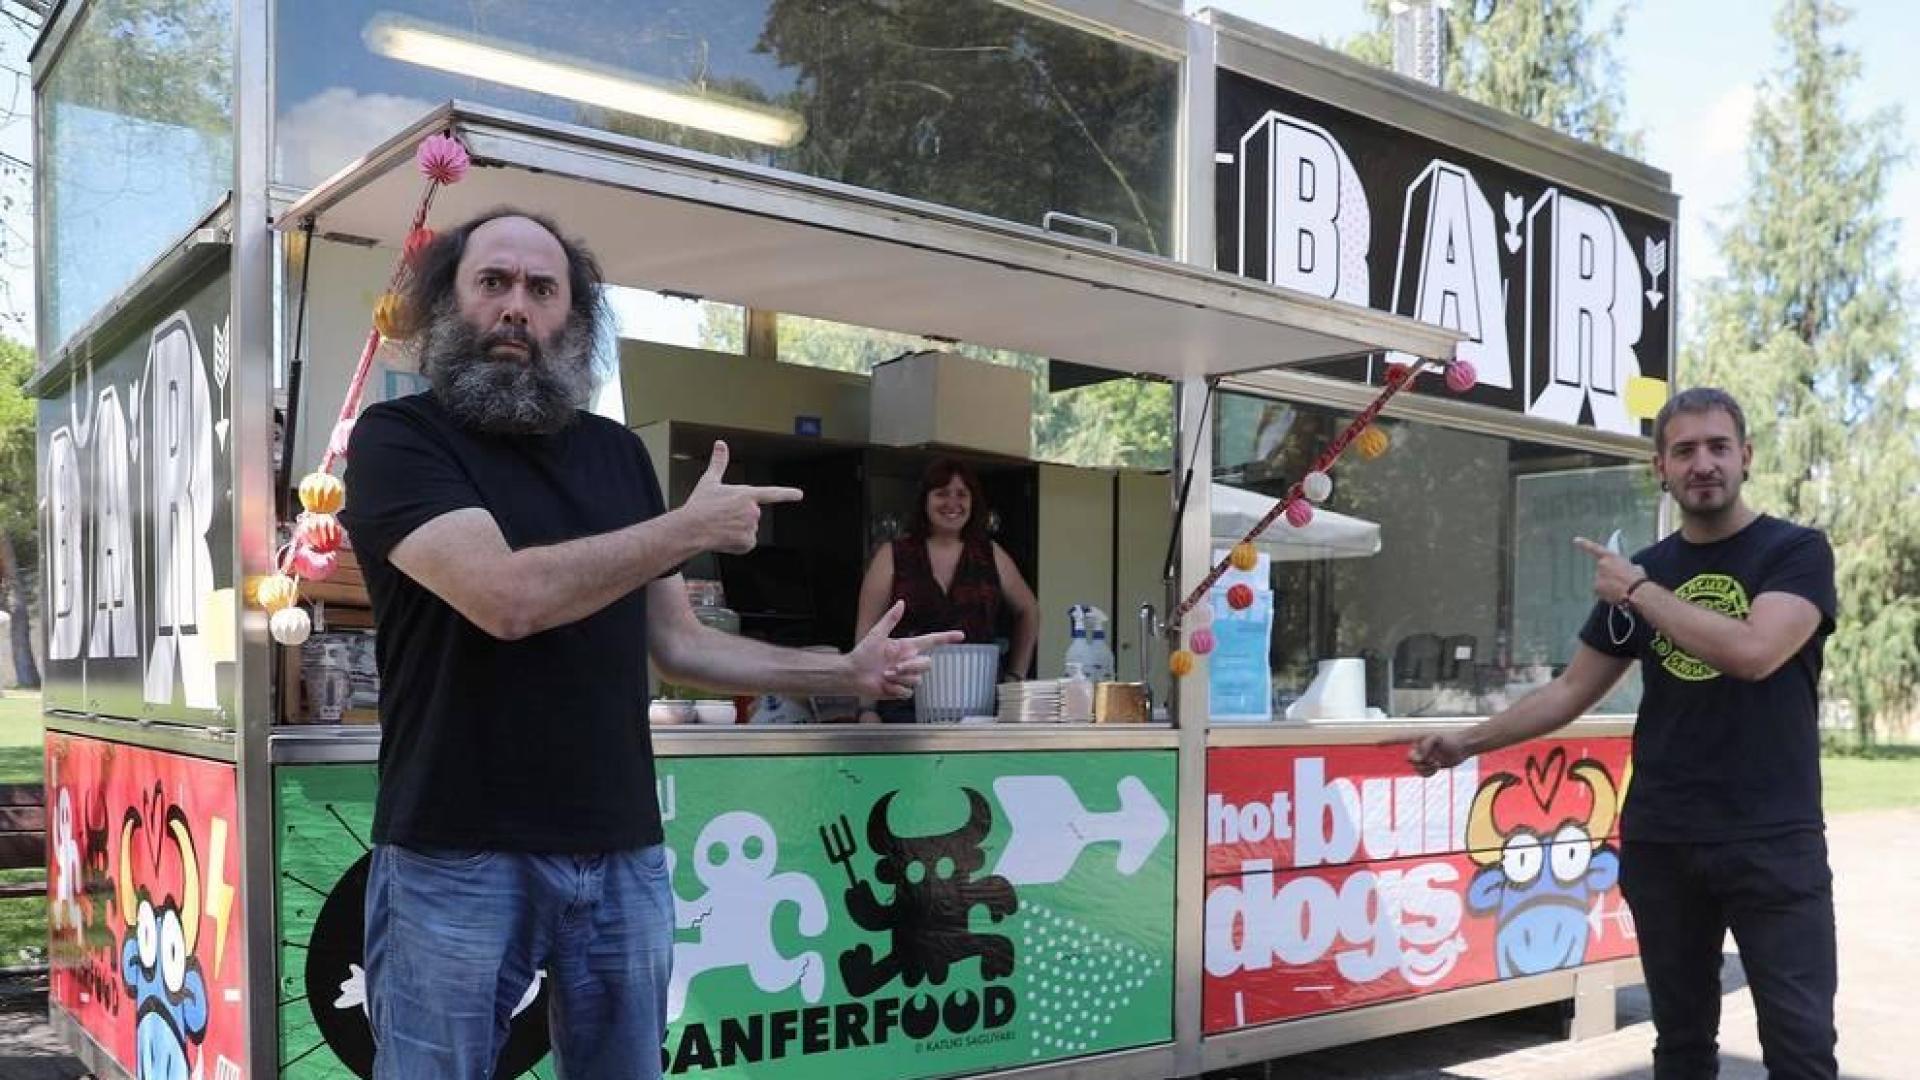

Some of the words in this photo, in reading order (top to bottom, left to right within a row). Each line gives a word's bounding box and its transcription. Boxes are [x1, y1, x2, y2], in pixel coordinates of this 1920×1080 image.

[1239, 109, 1643, 437] BAR
[1208, 791, 1293, 845] hot
[1293, 757, 1482, 867] bull
[1206, 858, 1464, 984] dogs
[661, 985, 1017, 1075] ANFERFOOD
